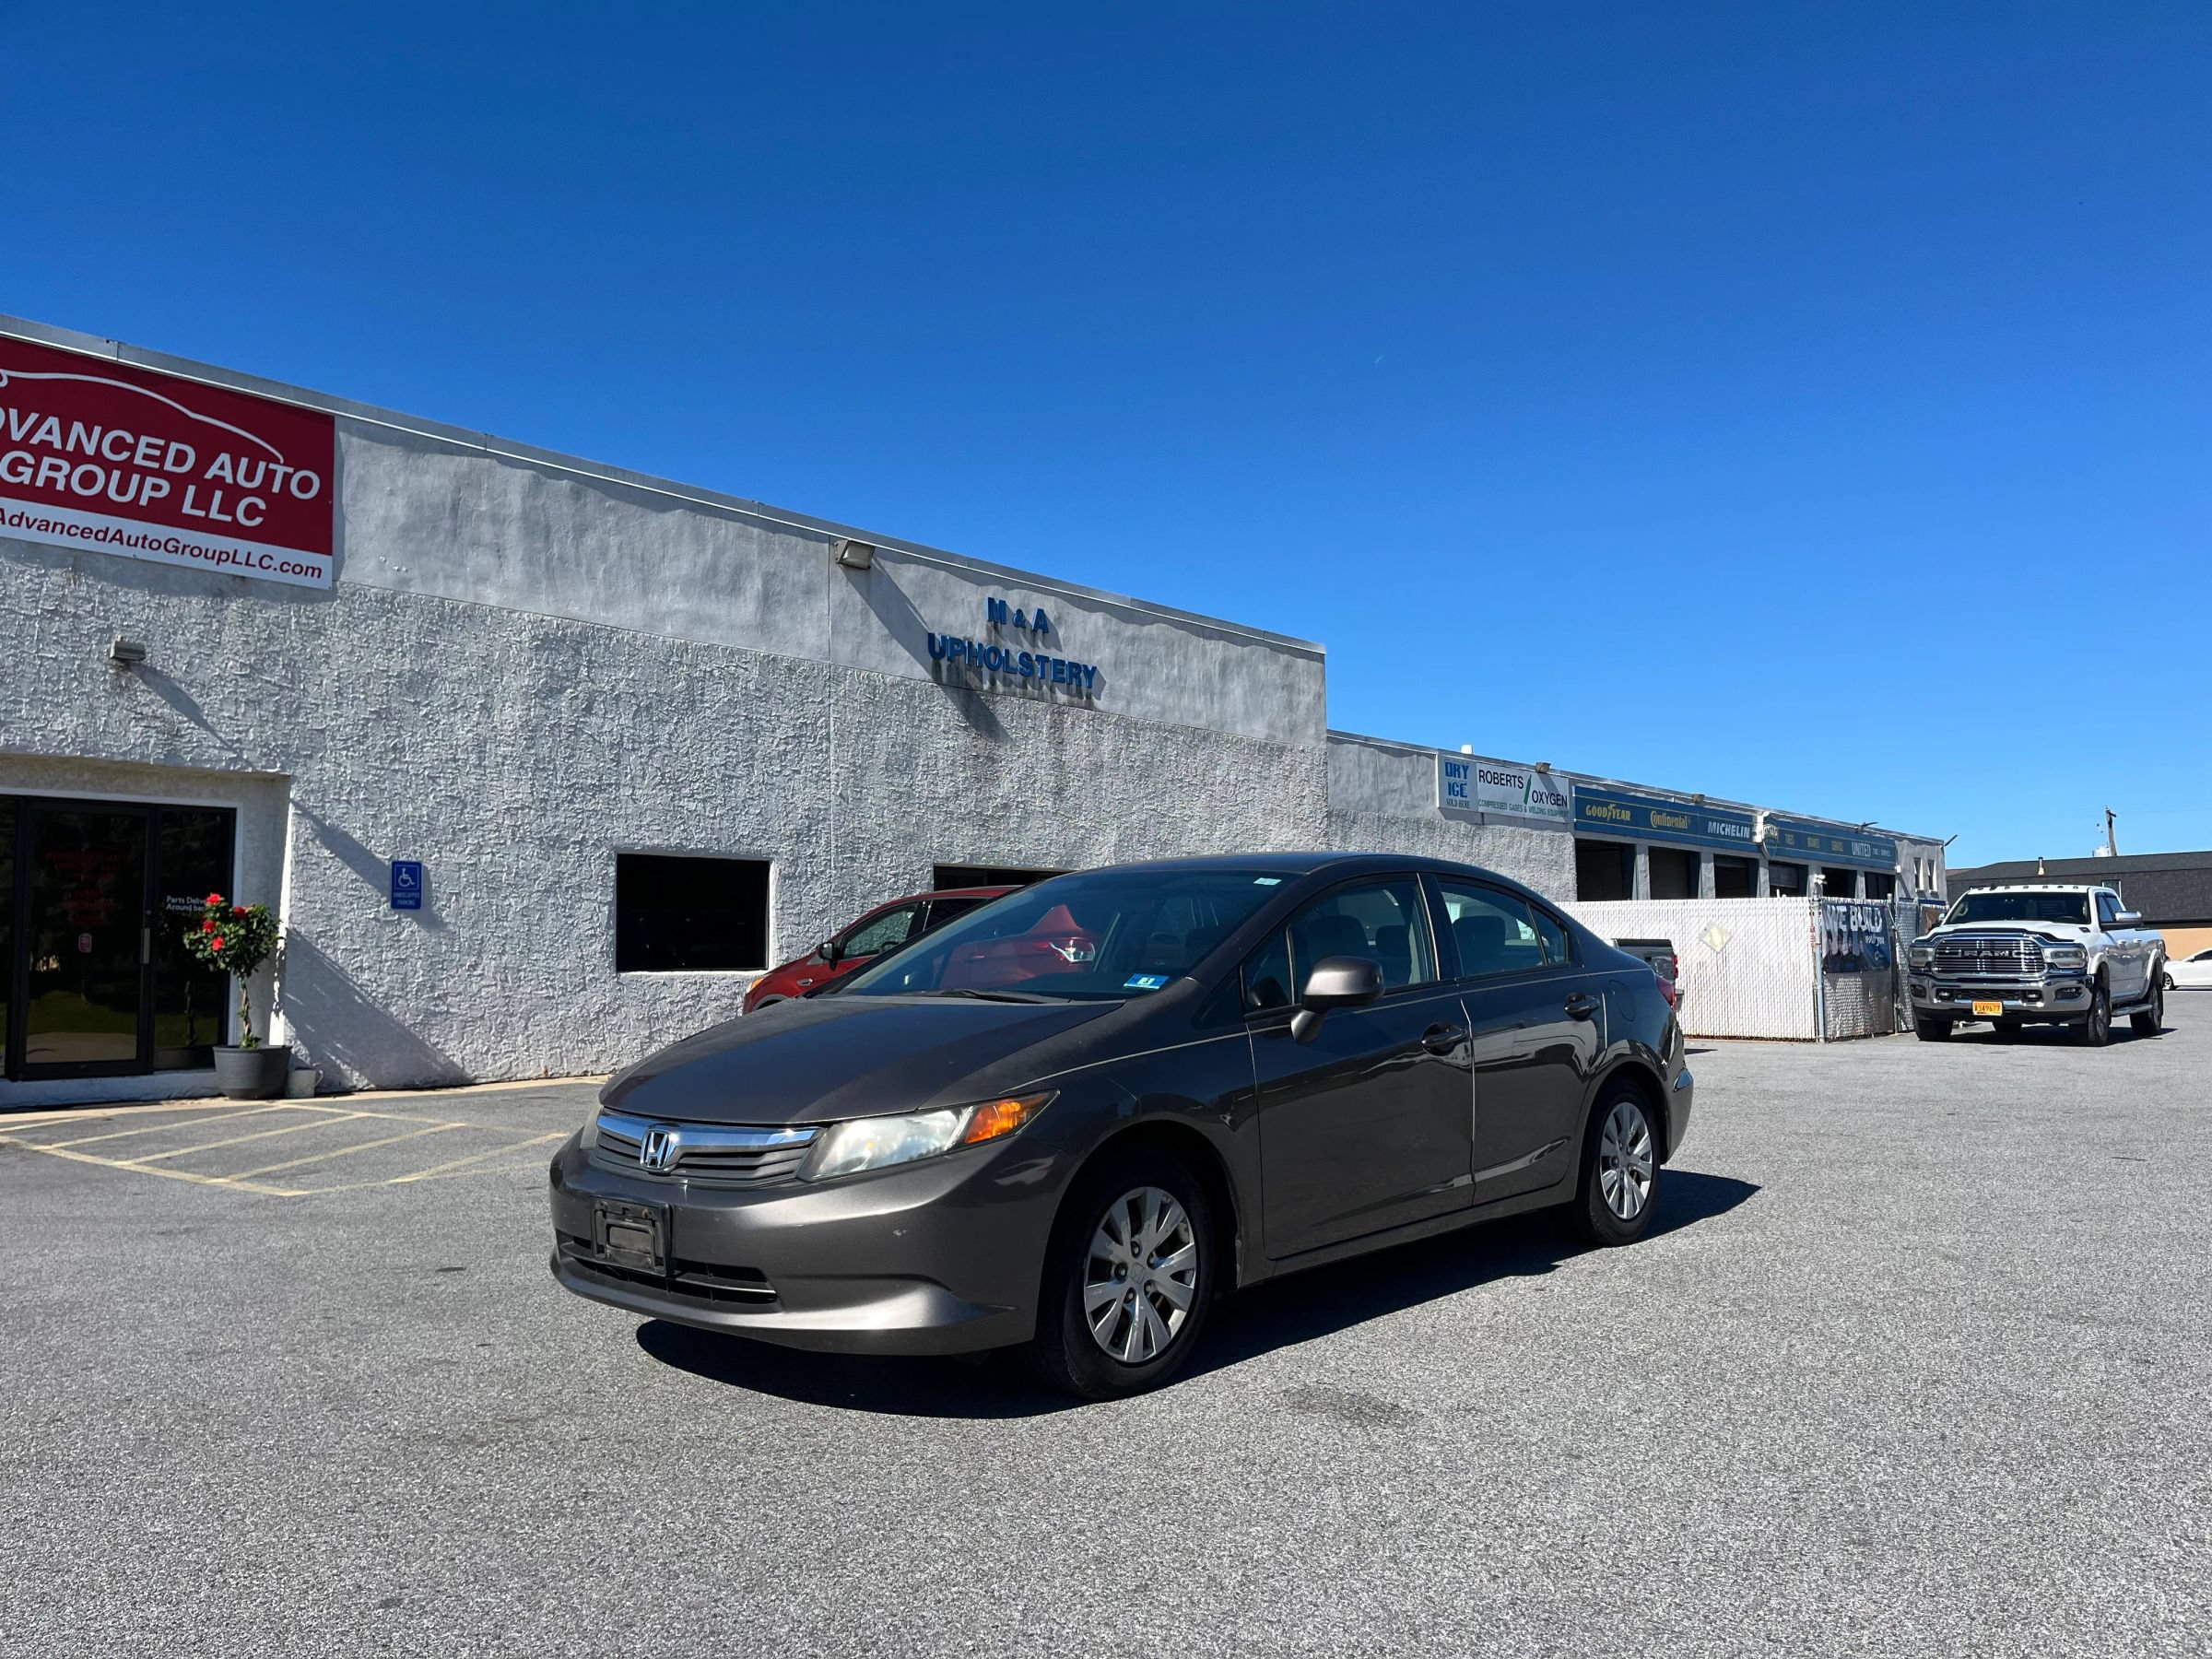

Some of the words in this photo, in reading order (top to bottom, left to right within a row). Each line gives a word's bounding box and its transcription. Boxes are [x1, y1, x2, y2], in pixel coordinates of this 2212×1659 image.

[0, 406, 196, 474] VANCED
[205, 453, 321, 500] AUTO
[0, 450, 171, 507] GROUP
[182, 485, 266, 527] LLC
[987, 596, 1007, 625] M
[1013, 608, 1027, 629] &
[1031, 607, 1050, 634] A
[927, 632, 1097, 688] UPHOLSTERY
[1444, 761, 1469, 780] DRY
[1478, 769, 1524, 790] ROBERTS
[1448, 781, 1468, 798] ICE
[1531, 790, 1568, 808] OXYGEN
[1477, 799, 1508, 810] COMPRESSED
[1509, 804, 1524, 813] GASES
[1585, 803, 1631, 822] GOODYEAR
[1650, 810, 1688, 830] Continental
[1707, 820, 1751, 839] MICHELIN
[1851, 841, 1872, 858] UNITED
[166, 895, 185, 903] Parts
[166, 903, 193, 912] Around
